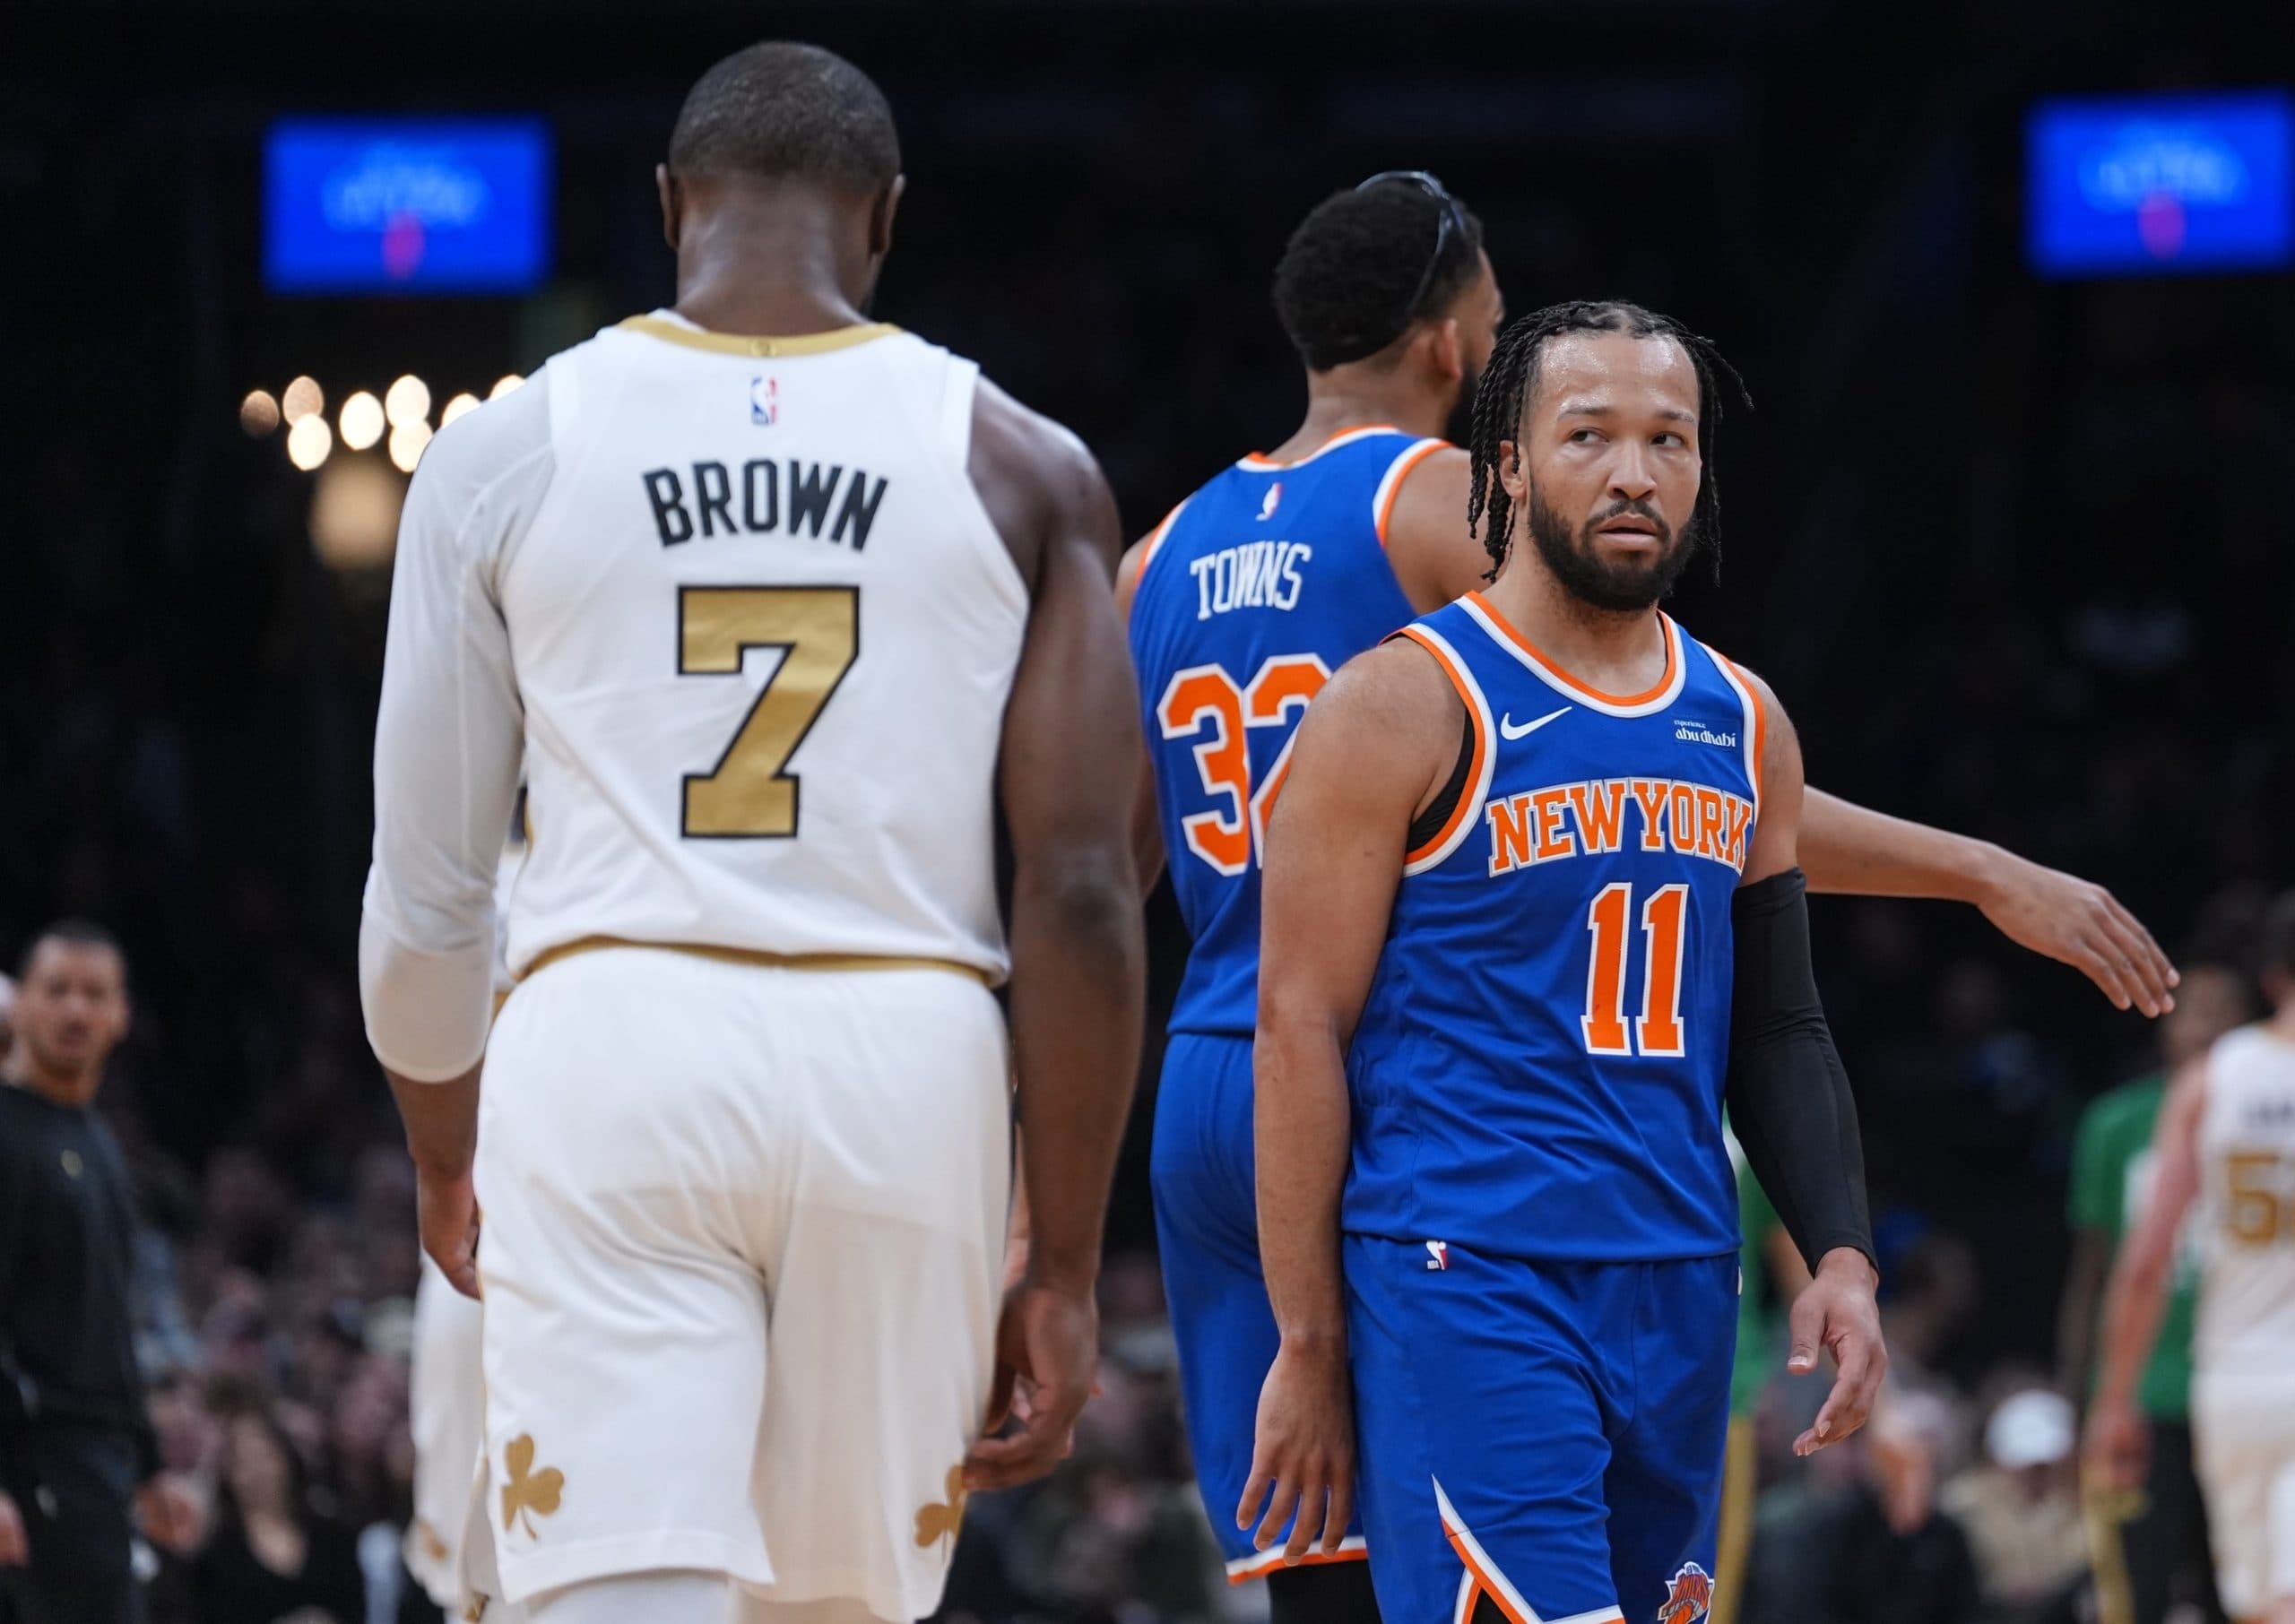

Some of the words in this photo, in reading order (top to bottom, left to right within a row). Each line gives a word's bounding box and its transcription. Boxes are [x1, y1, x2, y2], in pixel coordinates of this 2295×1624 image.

[643, 459, 888, 552] BROWN
[1190, 540, 1312, 621] TOWNS
[677, 584, 860, 839] 7
[1676, 728, 1700, 742] abu
[1700, 730, 1736, 747] dhabi
[1485, 779, 1628, 878] NEW
[1628, 776, 1754, 877] YORK
[1581, 882, 1690, 1058] 11
